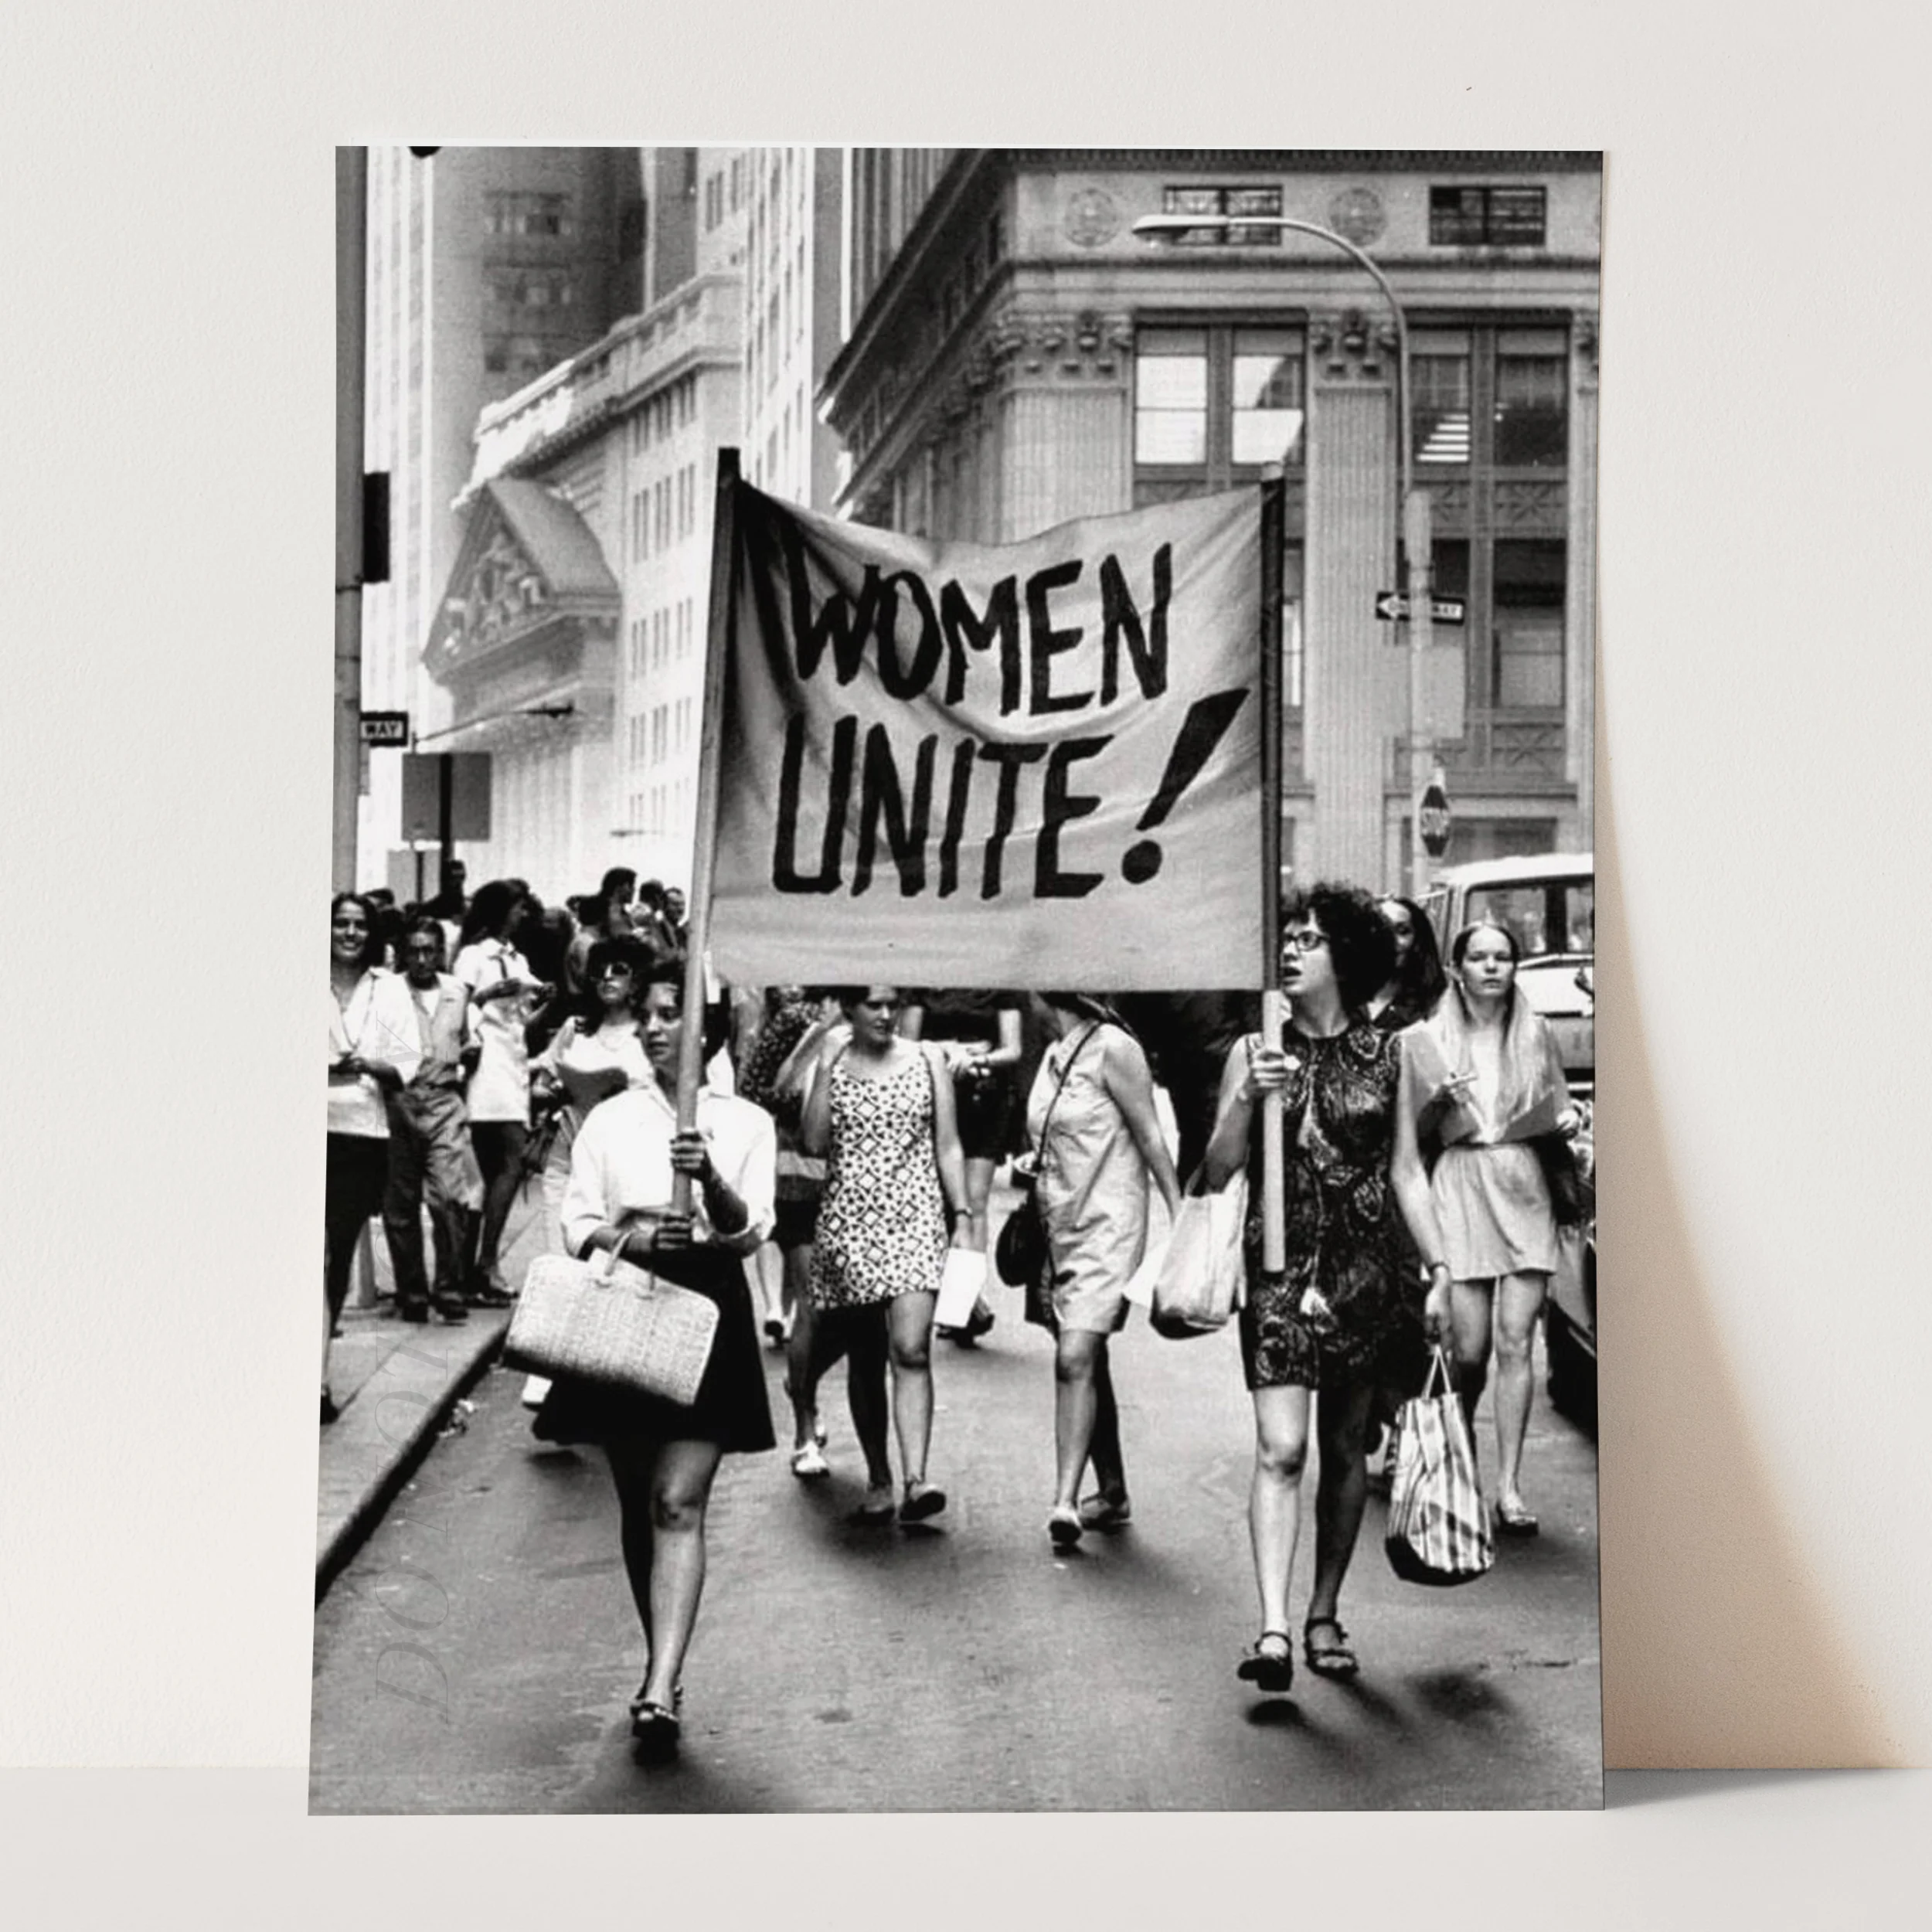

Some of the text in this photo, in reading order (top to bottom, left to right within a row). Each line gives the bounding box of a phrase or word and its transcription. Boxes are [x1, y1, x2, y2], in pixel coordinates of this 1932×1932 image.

[784, 539, 1172, 716] WOMEN
[365, 721, 399, 738] WAY
[773, 687, 1250, 900] UNITE!
